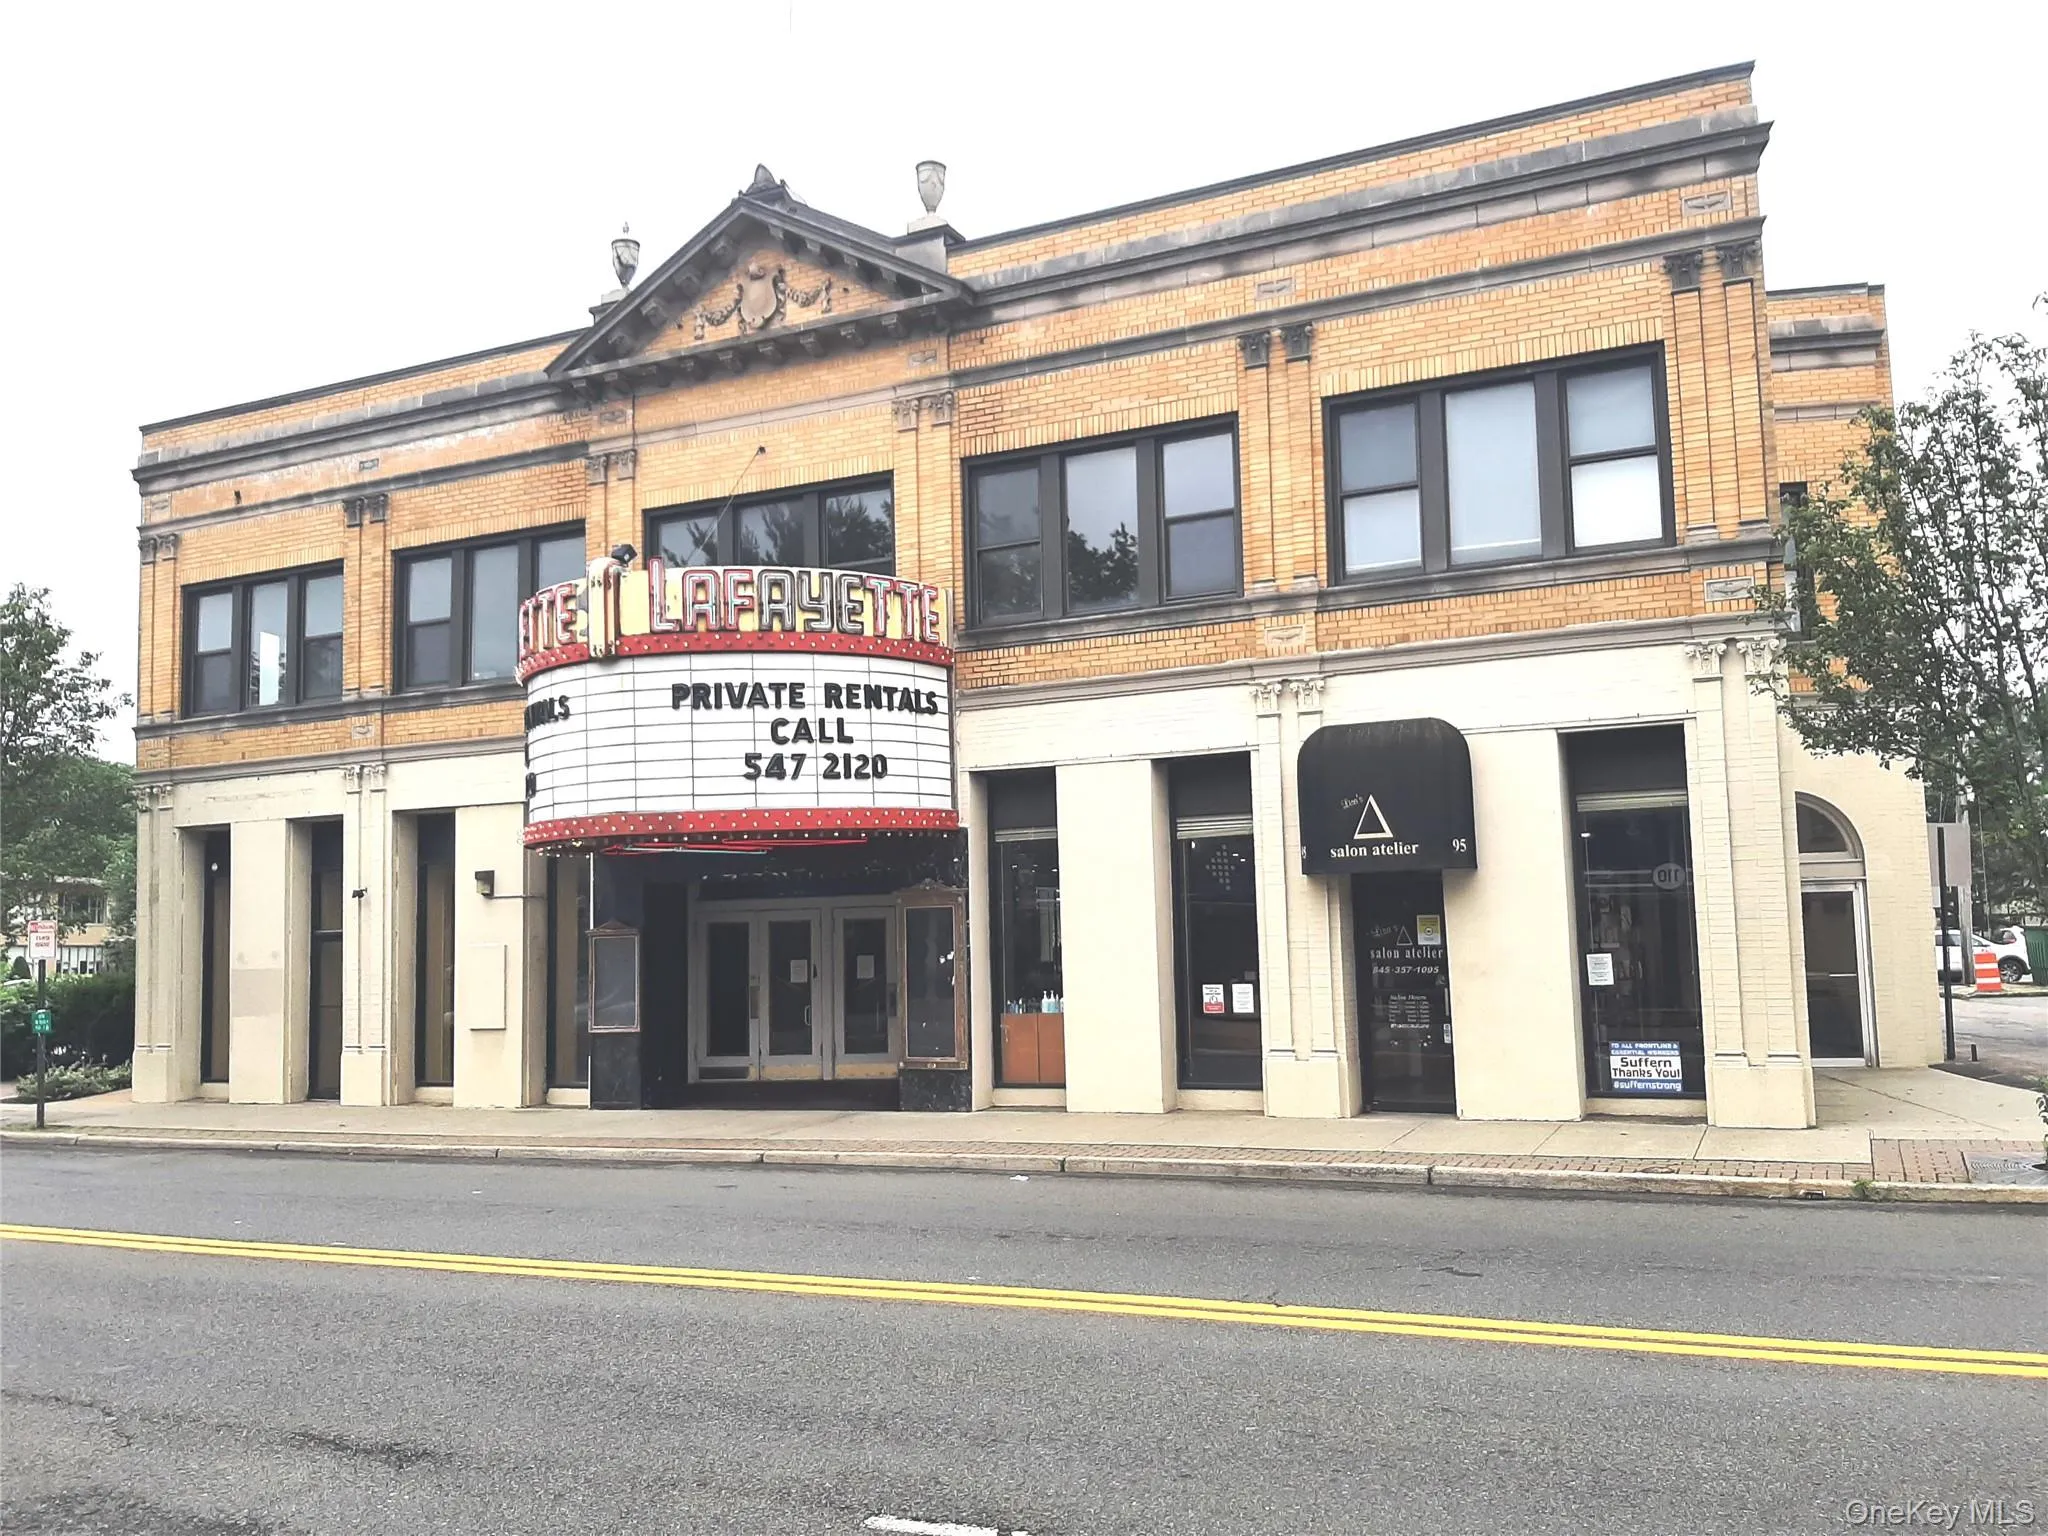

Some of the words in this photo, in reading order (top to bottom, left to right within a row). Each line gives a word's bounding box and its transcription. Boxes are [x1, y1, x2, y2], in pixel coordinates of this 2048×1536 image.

[649, 555, 939, 643] LAFAYETTE
[671, 682, 805, 709] PRIVATE
[823, 683, 938, 715] RENTALS
[770, 717, 854, 745] CALL
[743, 752, 805, 780] 547
[823, 752, 888, 779] 2120
[1330, 844, 1368, 858] salon
[1372, 842, 1419, 856] atelier
[1452, 839, 1467, 852] 95
[1370, 946, 1399, 959] salon
[1405, 946, 1443, 959] atelier
[1621, 1057, 1672, 1068] Suffern
[1612, 1067, 1653, 1078] Thanks
